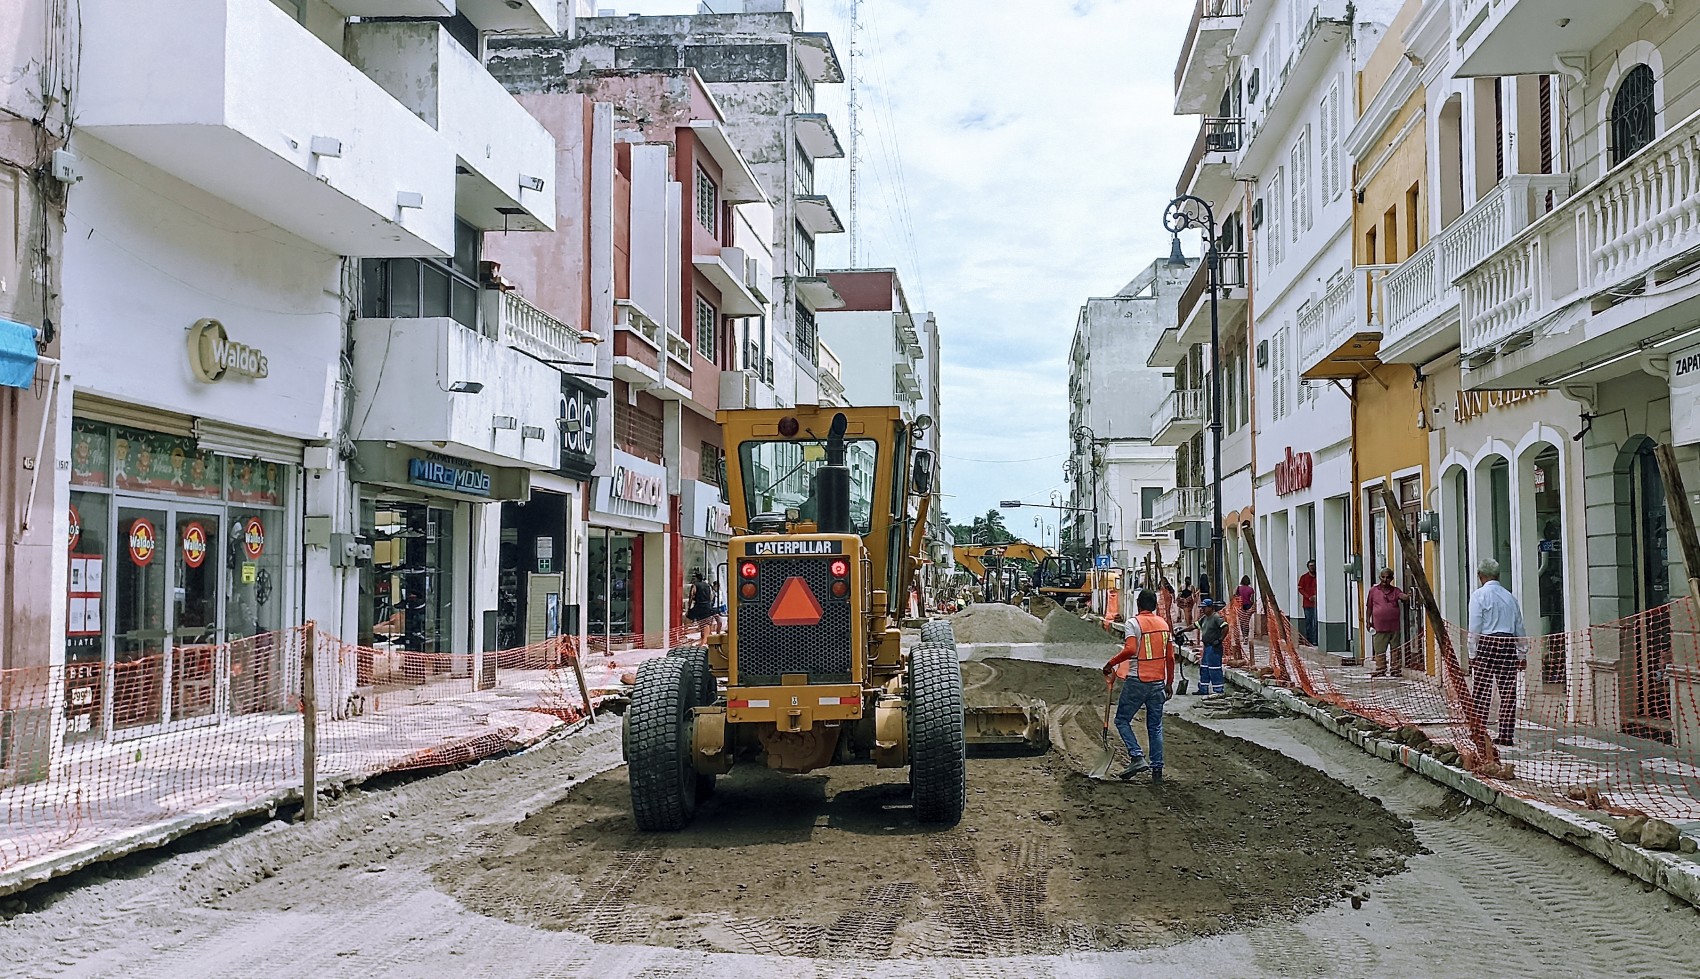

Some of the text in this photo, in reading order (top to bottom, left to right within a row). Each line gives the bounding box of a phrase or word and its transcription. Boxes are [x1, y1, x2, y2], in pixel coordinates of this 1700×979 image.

[212, 340, 267, 377] Waldo's
[130, 535, 155, 550] Waldo's
[183, 538, 206, 552] Waldo's
[245, 532, 264, 545] Waldo's
[755, 541, 832, 555] CATERPILLAR
